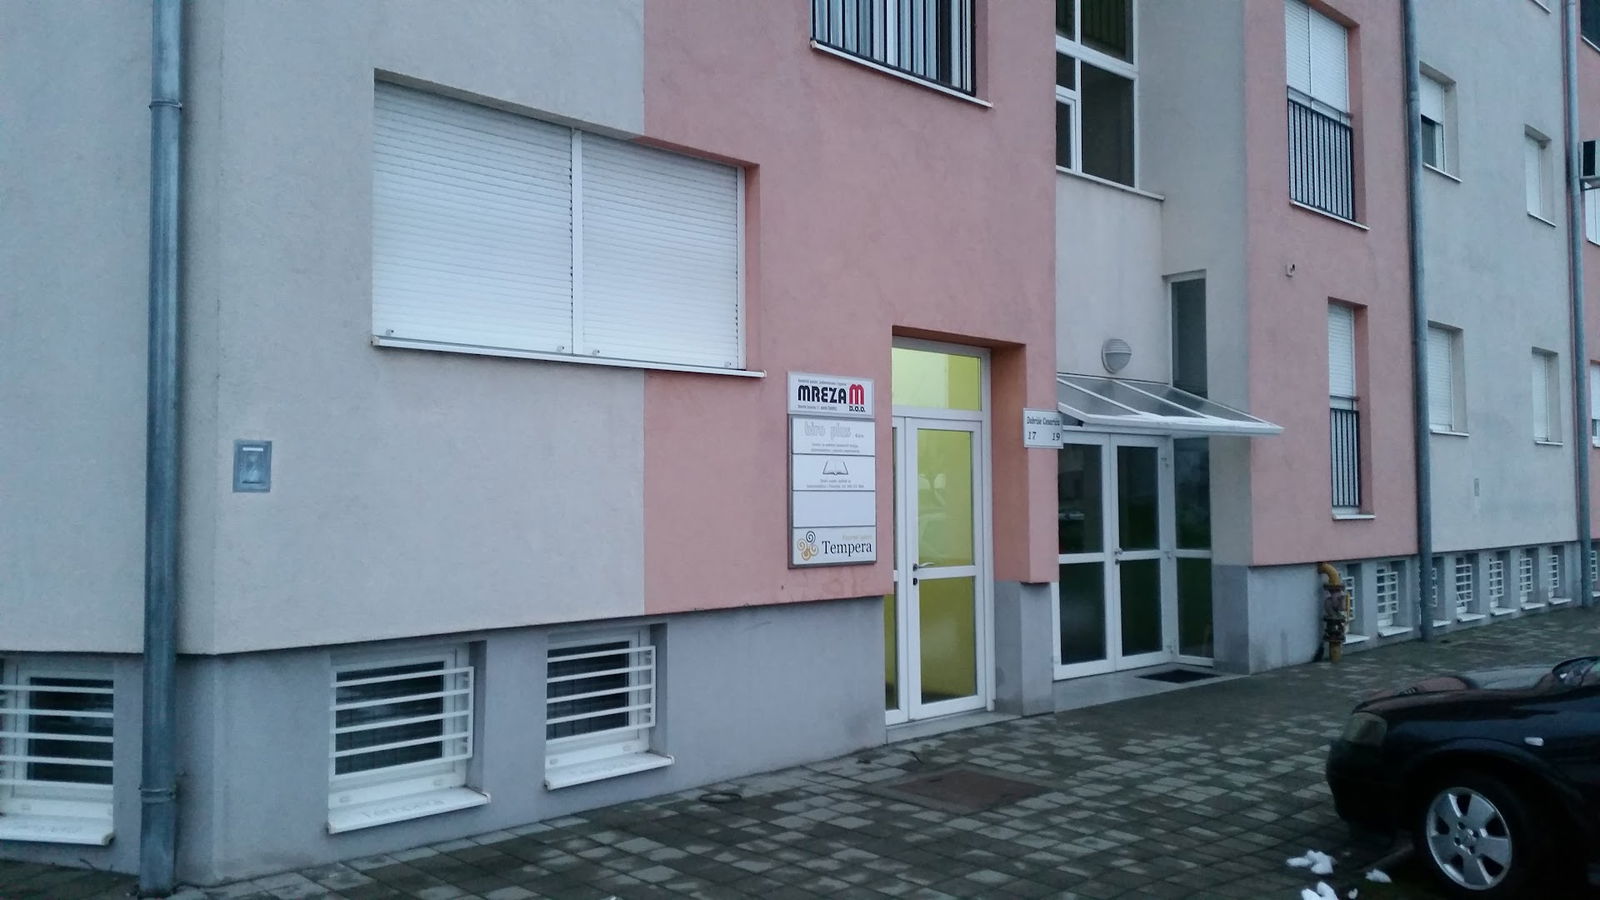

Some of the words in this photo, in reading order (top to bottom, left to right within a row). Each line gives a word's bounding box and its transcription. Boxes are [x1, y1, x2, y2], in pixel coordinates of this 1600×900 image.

[1028, 431, 1037, 440] 17
[1052, 432, 1061, 441] 19
[821, 540, 872, 557] Tempera
